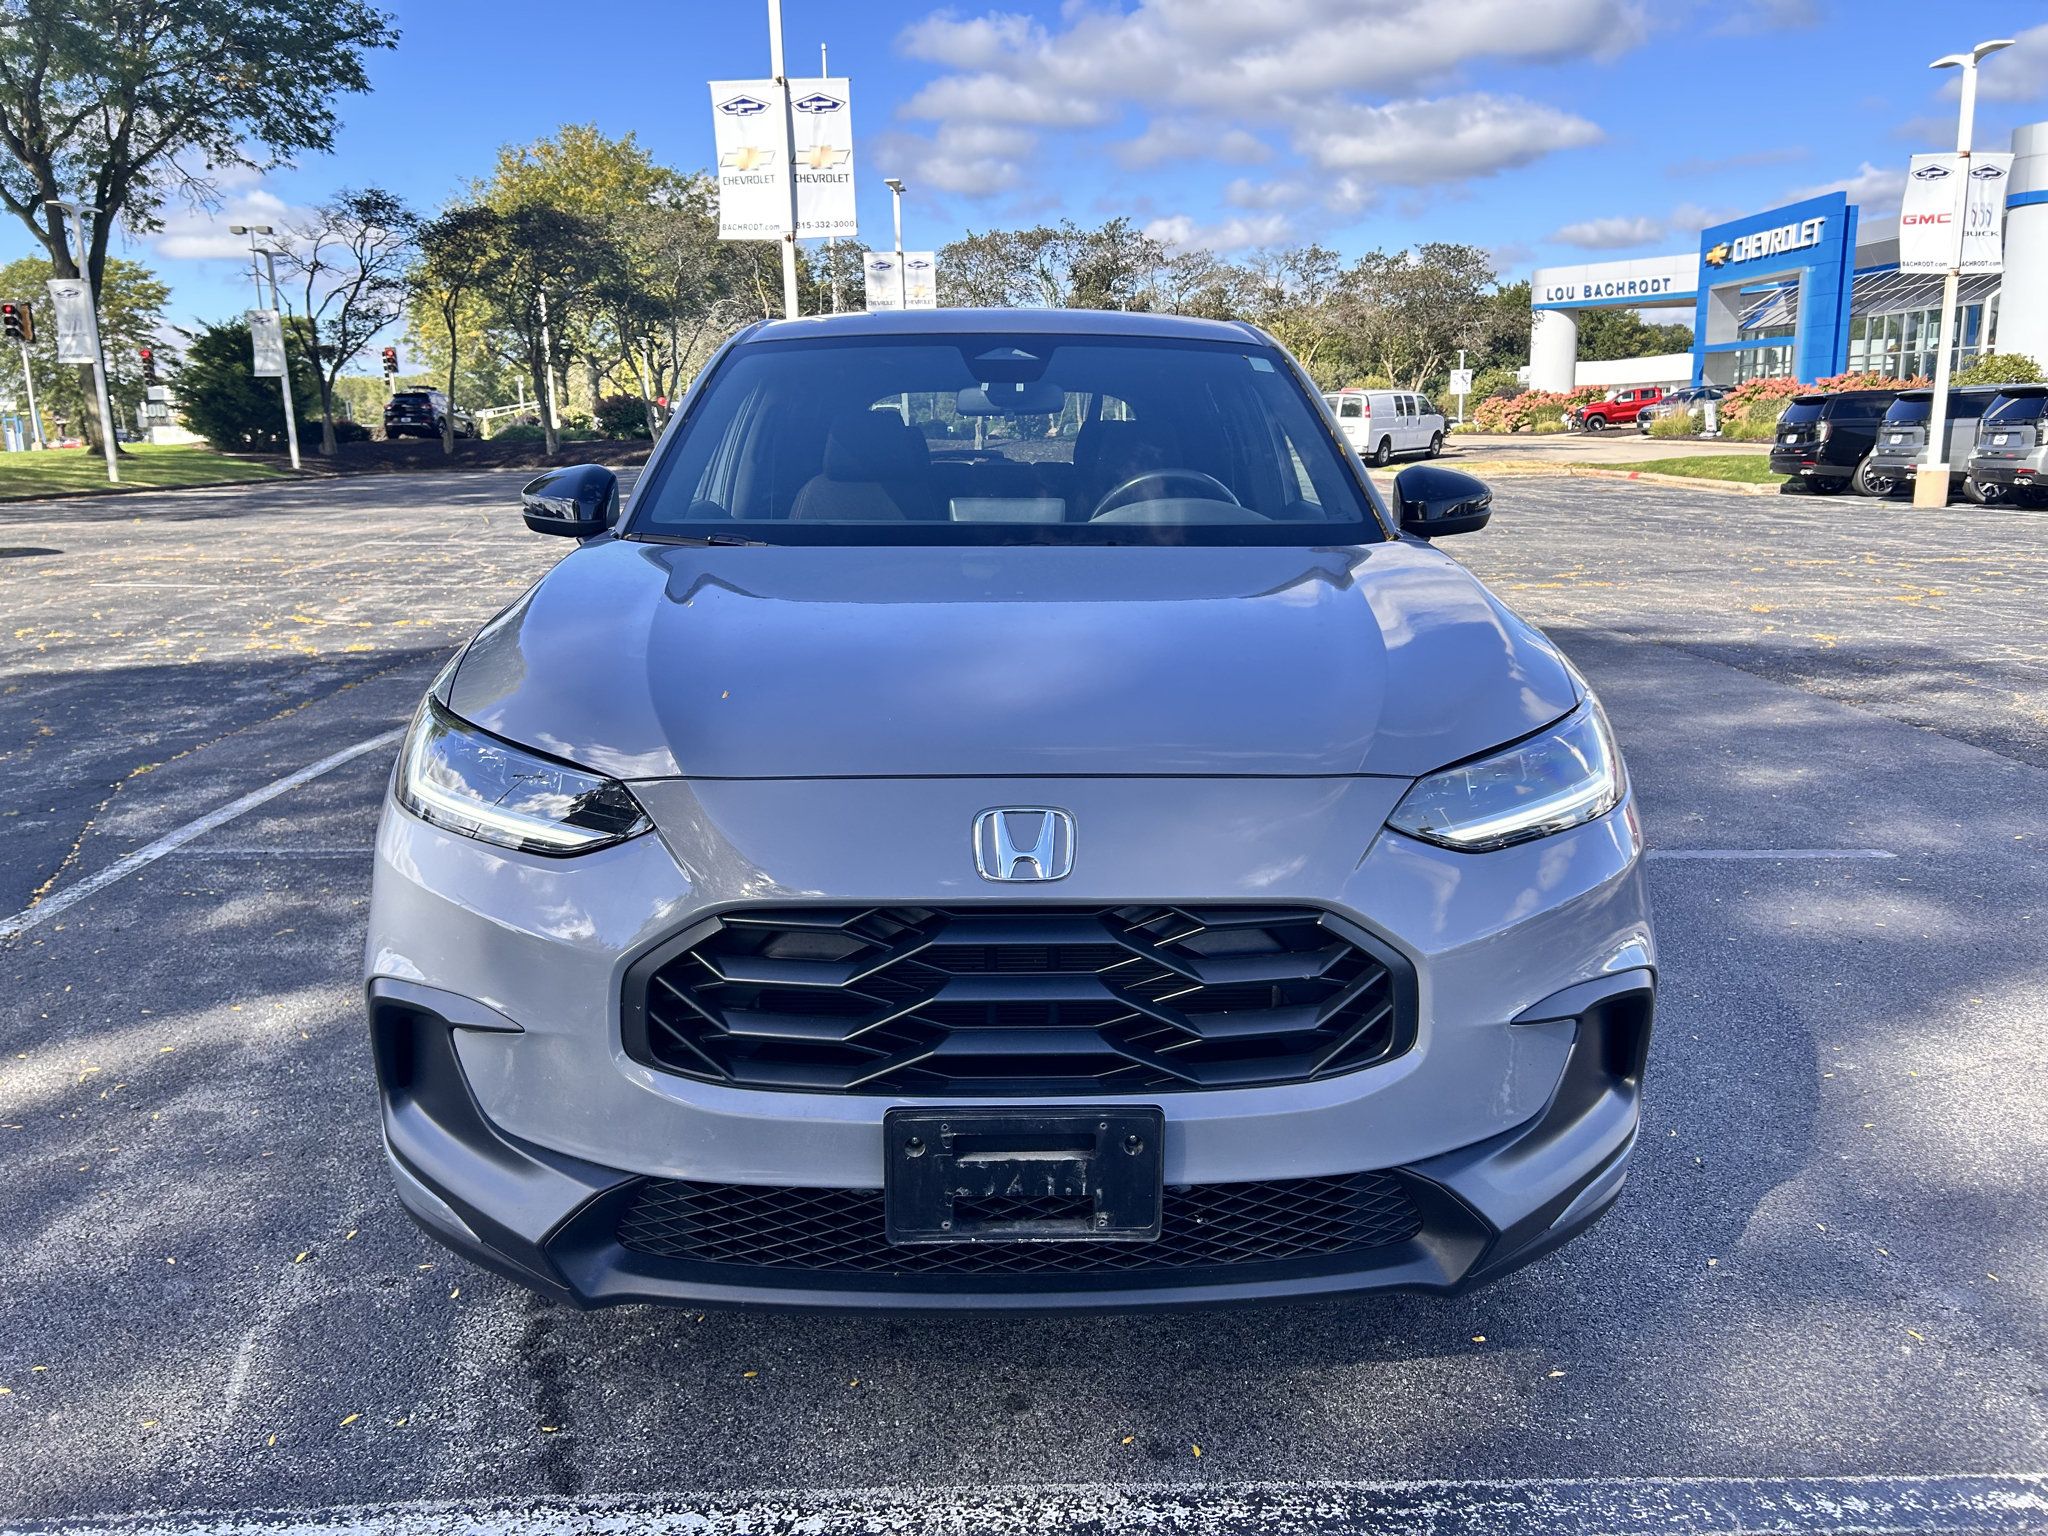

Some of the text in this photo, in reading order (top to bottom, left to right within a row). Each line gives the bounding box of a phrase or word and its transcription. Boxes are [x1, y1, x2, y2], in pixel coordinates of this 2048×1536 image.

[722, 174, 775, 186] CHEVROLET
[794, 173, 850, 184] CHEVROLET
[795, 220, 855, 229] 815-332-3000
[1903, 213, 1952, 225] GMC
[1731, 215, 1825, 263] CHEVROLET
[1546, 278, 1671, 301] LOU BACHRODT
